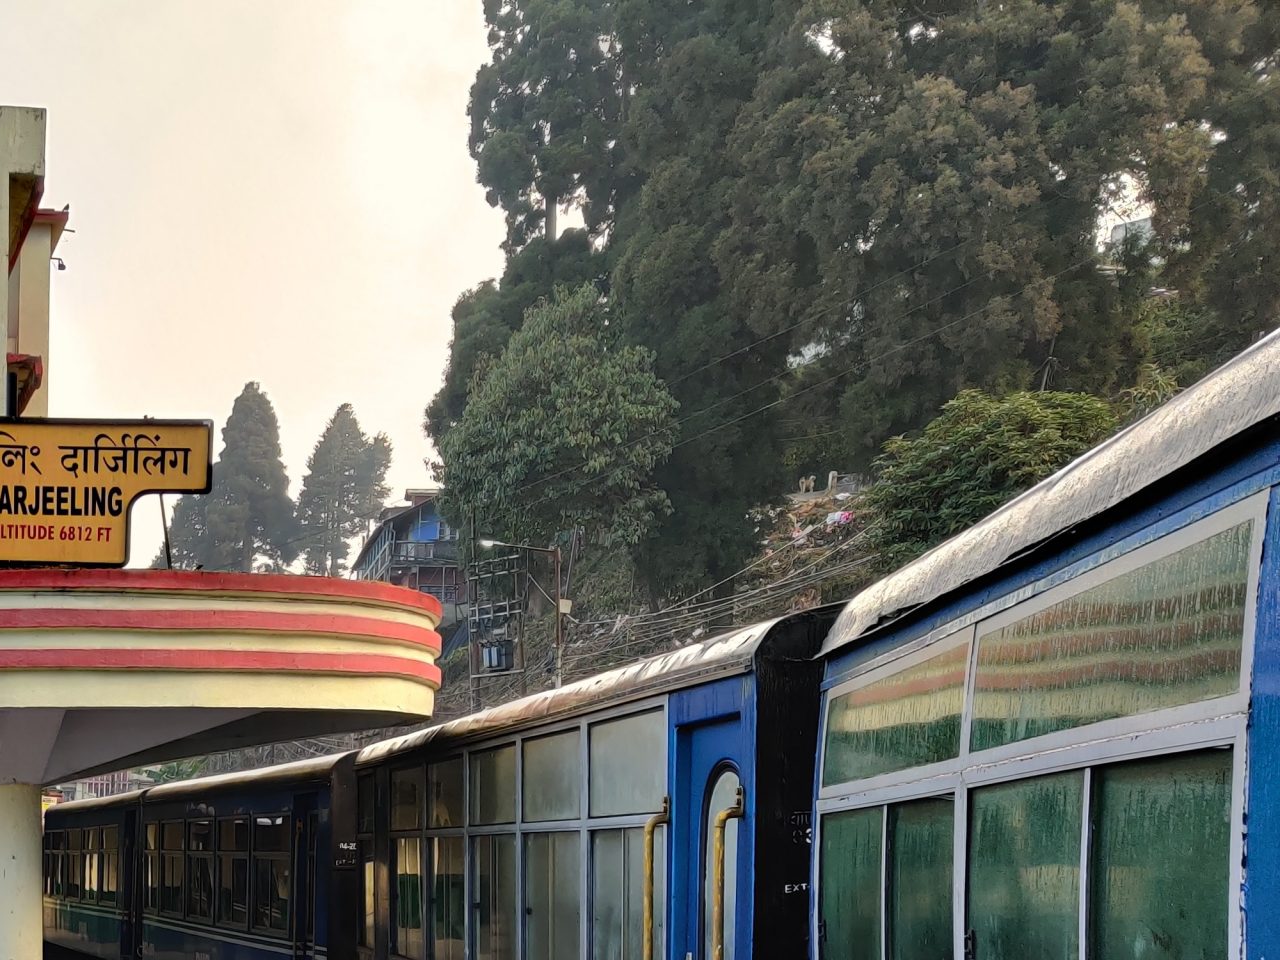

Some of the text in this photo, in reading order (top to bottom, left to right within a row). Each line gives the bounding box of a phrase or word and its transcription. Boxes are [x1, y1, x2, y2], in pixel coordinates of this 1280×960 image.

[58, 433, 192, 478] दार्जिलिंग
[59, 526, 93, 542] 6812
[97, 527, 112, 543] FT
